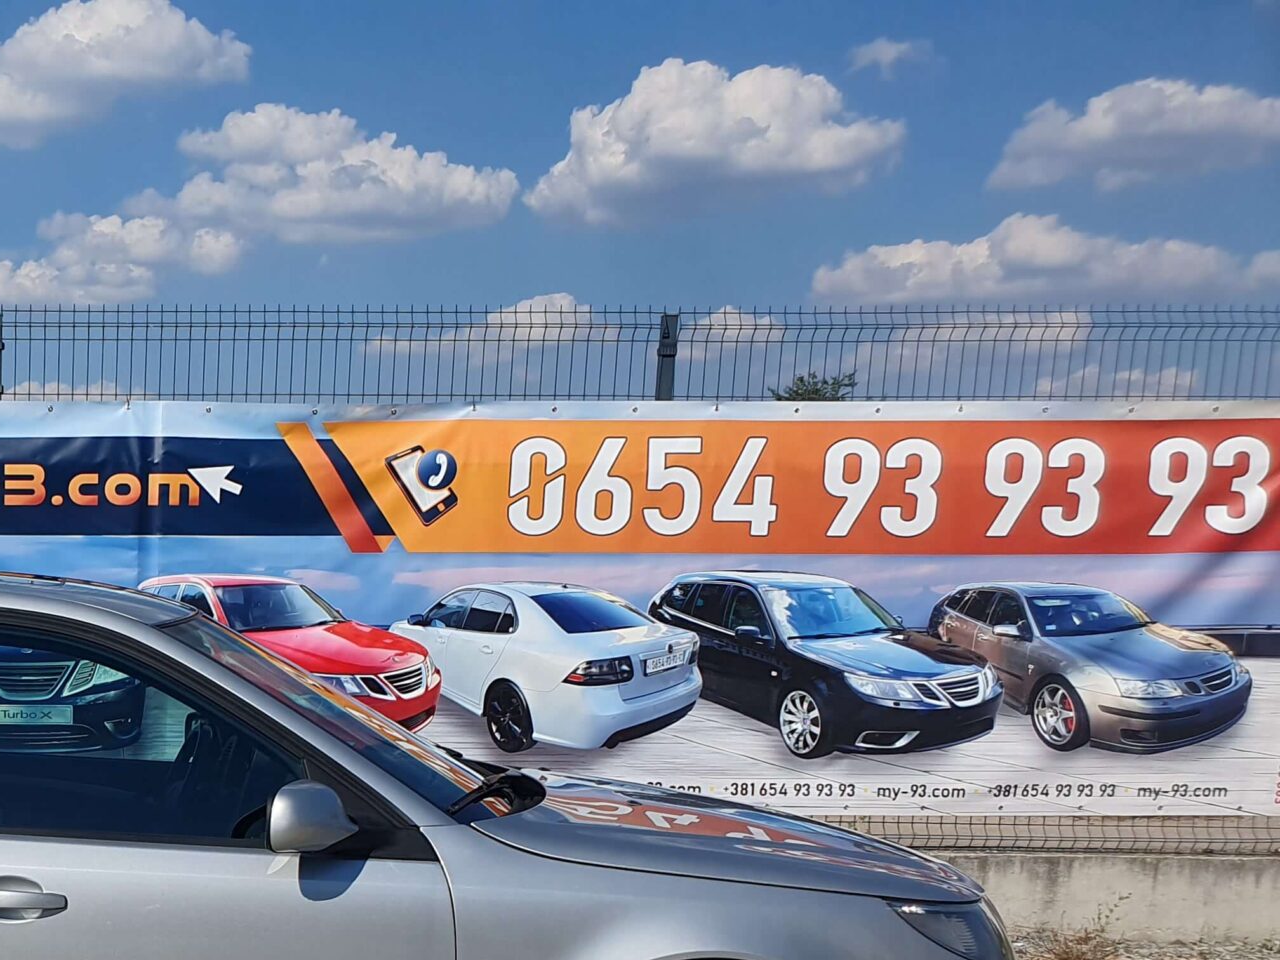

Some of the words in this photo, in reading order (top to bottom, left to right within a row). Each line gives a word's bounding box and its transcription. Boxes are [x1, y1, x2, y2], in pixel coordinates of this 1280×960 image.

[507, 435, 778, 536] 0654
[823, 437, 943, 537] 93
[984, 437, 1106, 537] 93
[1147, 435, 1271, 537] 93
[0, 709, 37, 720] Turbo
[40, 711, 53, 720] X
[793, 783, 811, 797] 93
[816, 783, 833, 797] 93
[838, 783, 856, 797] 93
[876, 784, 966, 801] my-93.com
[1055, 783, 1072, 798] 93
[1077, 783, 1094, 798] 93
[1099, 783, 1116, 798] 93
[1136, 783, 1228, 801] my-93.com
